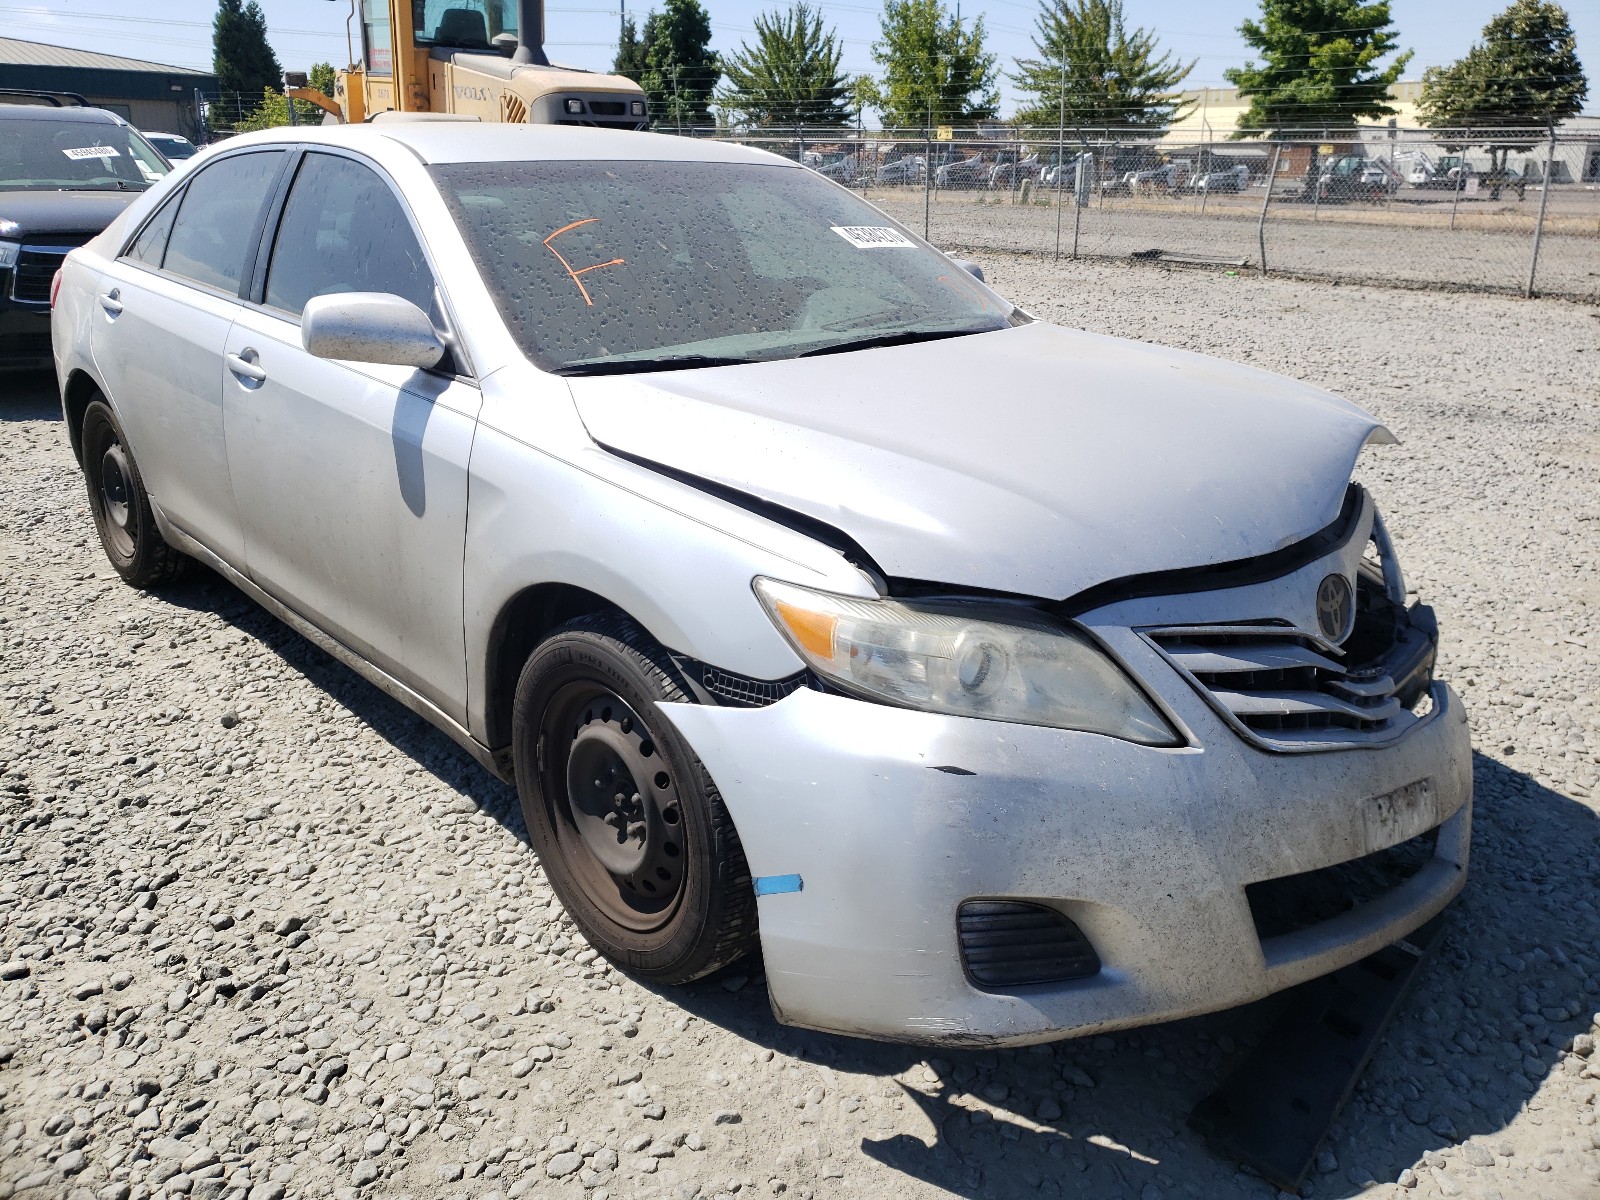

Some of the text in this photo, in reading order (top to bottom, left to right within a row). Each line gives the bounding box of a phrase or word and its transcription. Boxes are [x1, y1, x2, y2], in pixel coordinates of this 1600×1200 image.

[454, 86, 499, 101] VOLV
[843, 227, 905, 243] 46384270
[543, 218, 625, 307] F
